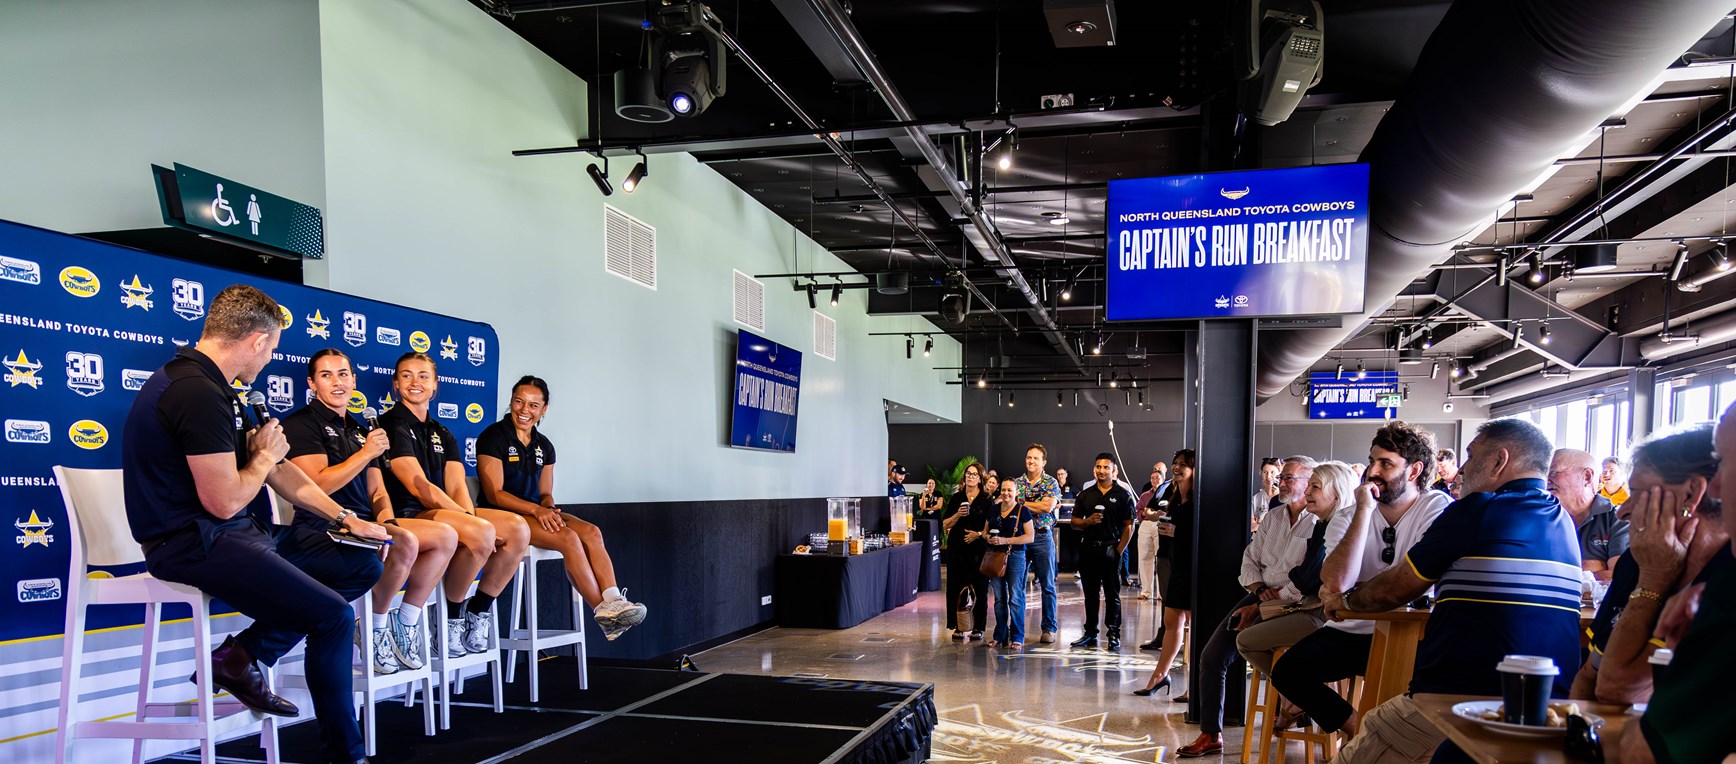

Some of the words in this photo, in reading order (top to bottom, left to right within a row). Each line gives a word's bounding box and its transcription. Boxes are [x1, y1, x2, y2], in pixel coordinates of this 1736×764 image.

[1119, 211, 1159, 222] NORTH
[1161, 207, 1241, 220] QUEENSLAND
[1243, 204, 1290, 215] TOYOTA
[1292, 200, 1355, 213] COWBOYS
[1119, 225, 1207, 271] CAPTAIN'S
[1211, 223, 1248, 266] RUN
[1252, 218, 1355, 265] BREAKFAST
[172, 278, 204, 306] 30
[343, 311, 367, 334] 30
[65, 323, 110, 338] TOYOTA
[113, 330, 164, 345] COWBOYS
[468, 336, 485, 356] 30
[66, 351, 103, 381] 30
[286, 354, 312, 364] TOYOT
[3, 373, 43, 386] COWBOYS
[267, 375, 294, 399] 30
[437, 375, 459, 385] TOYOTA
[460, 378, 486, 388] COWBOYS
[8, 430, 49, 441] COWBOYS
[73, 434, 105, 444] COWBOYS
[0, 476, 60, 487] UEENSLA
[16, 534, 54, 544] COWBOYS
[20, 588, 60, 601] COWBOYS
